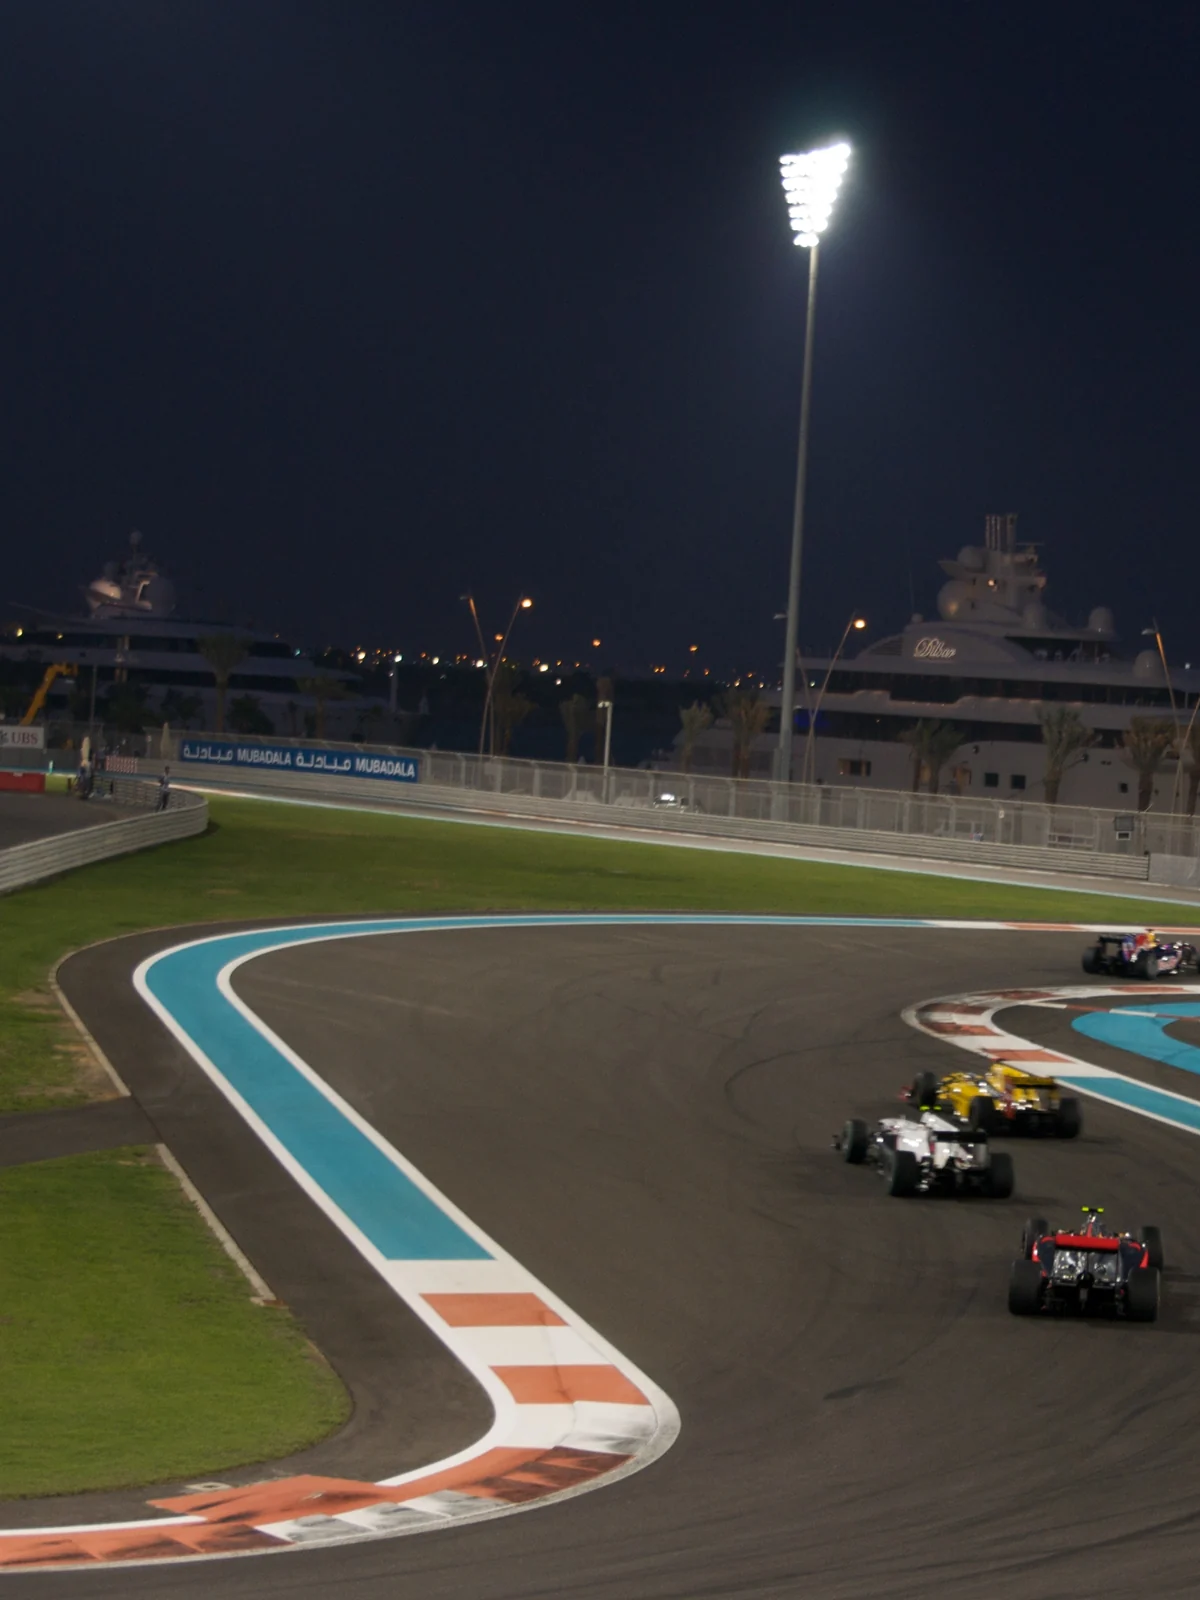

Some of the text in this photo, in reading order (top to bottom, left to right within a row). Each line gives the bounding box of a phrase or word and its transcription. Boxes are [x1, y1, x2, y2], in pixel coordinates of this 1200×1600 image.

[913, 636, 957, 658] Dilbar
[10, 731, 39, 746] UBS
[236, 748, 292, 766] MUBADALA
[355, 757, 416, 777] MUBADALA
